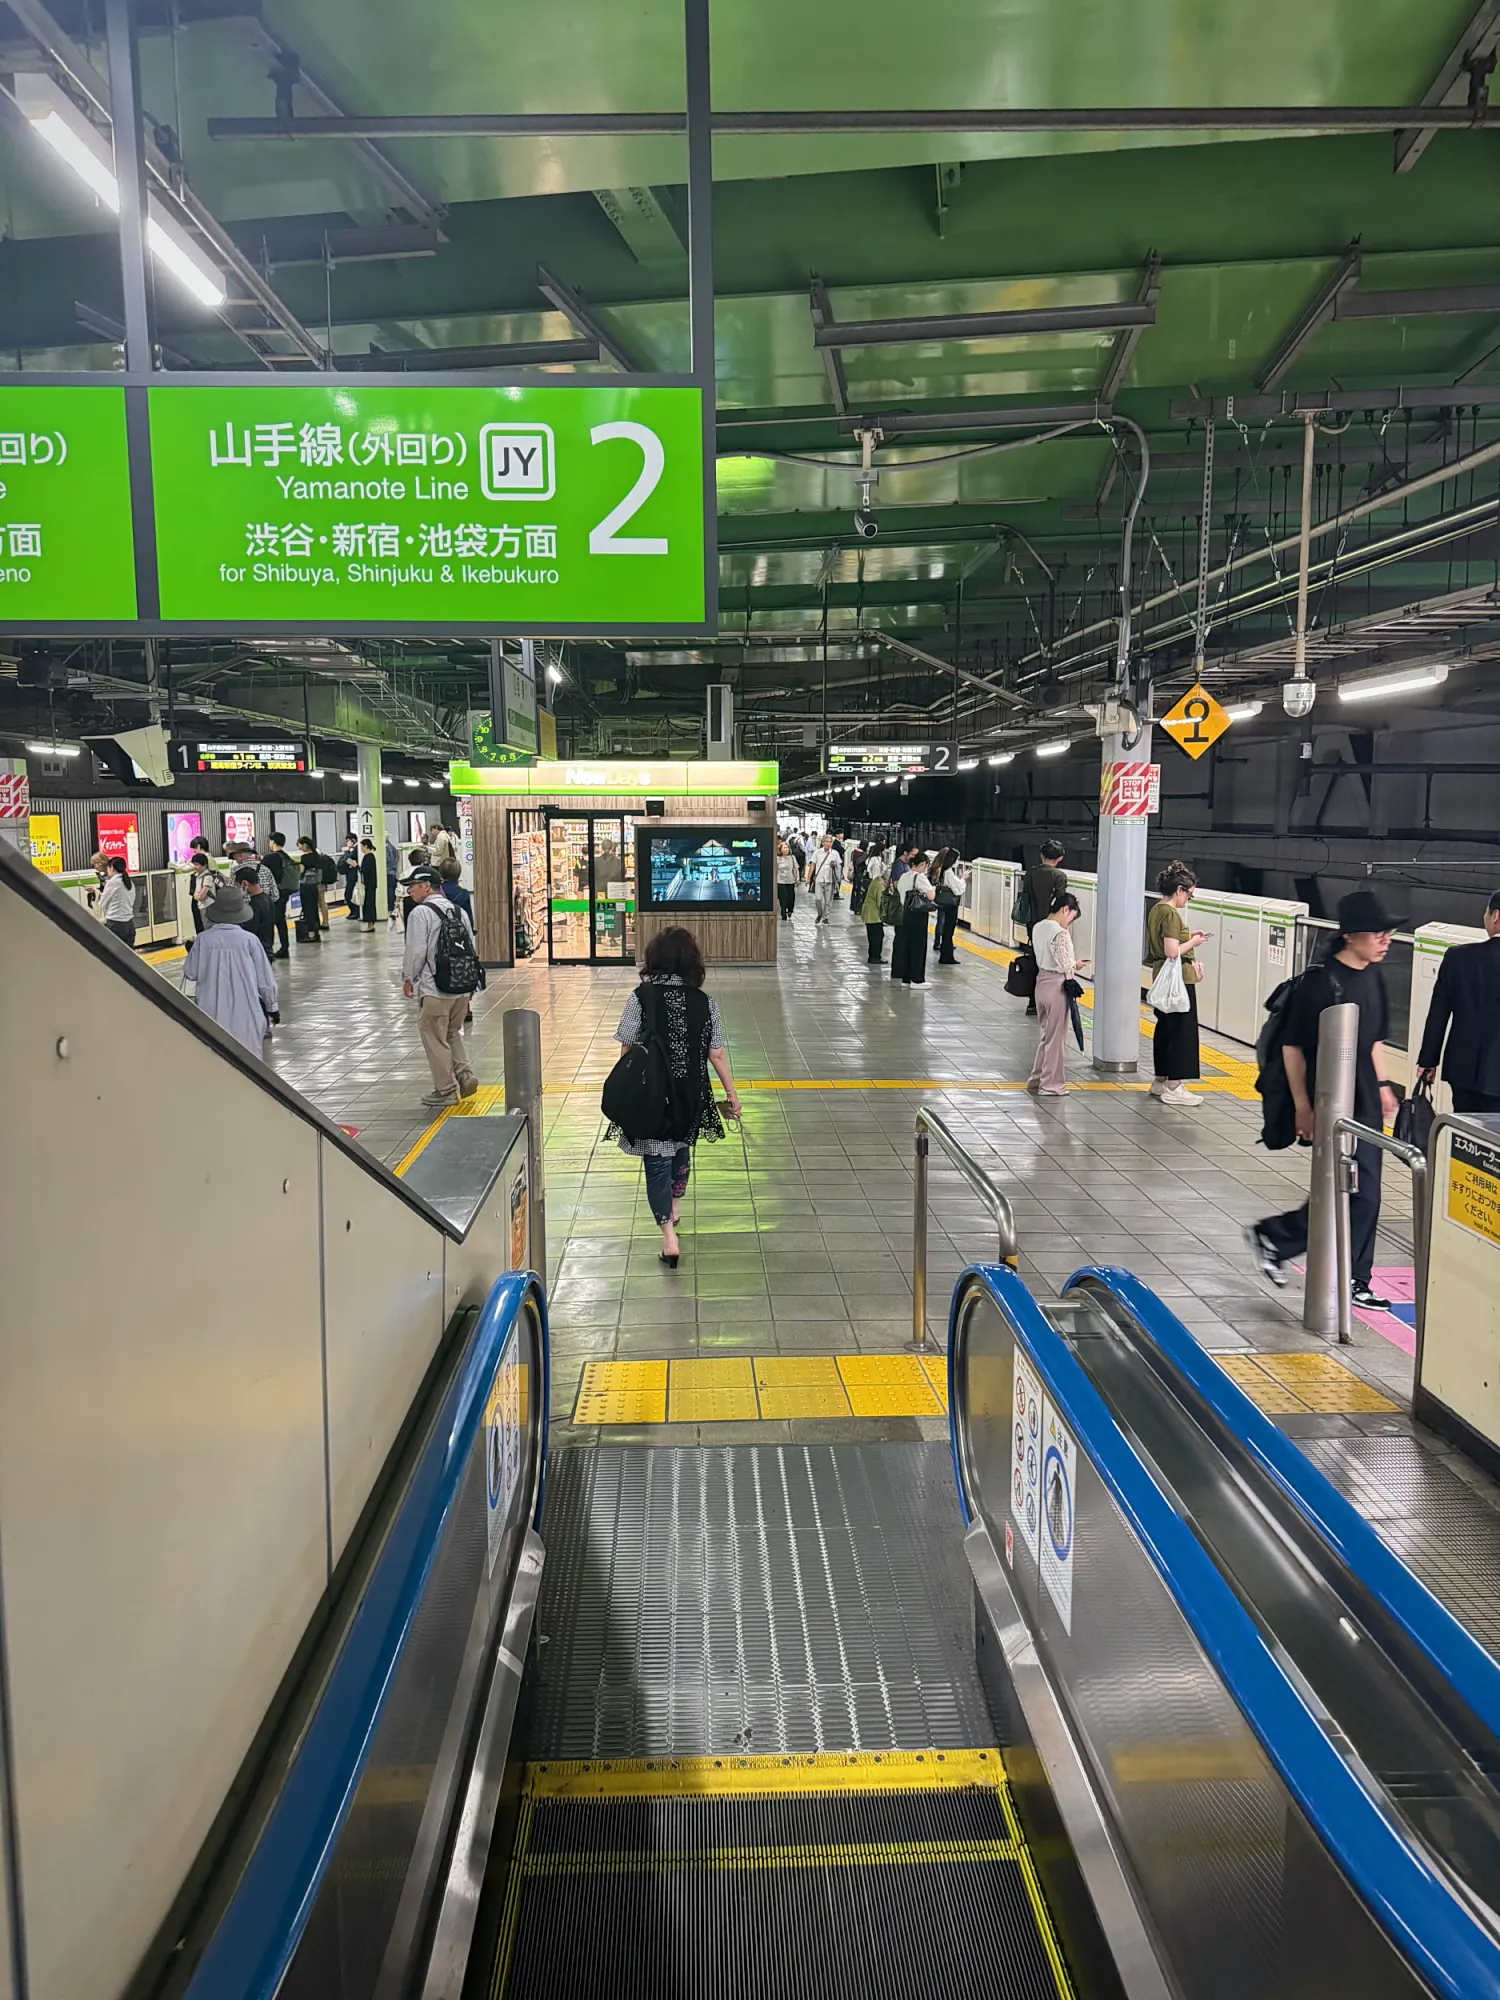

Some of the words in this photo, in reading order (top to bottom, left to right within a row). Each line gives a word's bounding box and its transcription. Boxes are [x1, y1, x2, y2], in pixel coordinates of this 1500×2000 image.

[209, 421, 467, 467] 山手線(外回り)
[498, 447, 537, 476] JY
[276, 476, 406, 500] Yamanote
[415, 476, 469, 500] Line
[588, 420, 669, 555] 2
[245, 522, 558, 559] 渋谷・新宿・池袋方面
[219, 563, 247, 583] for
[253, 564, 340, 587] Shibuya,
[347, 564, 433, 587] Shinjuku
[440, 566, 455, 583] &
[462, 565, 559, 584] Ikebukuro
[177, 744, 189, 769] 1
[934, 746, 950, 771] 2
